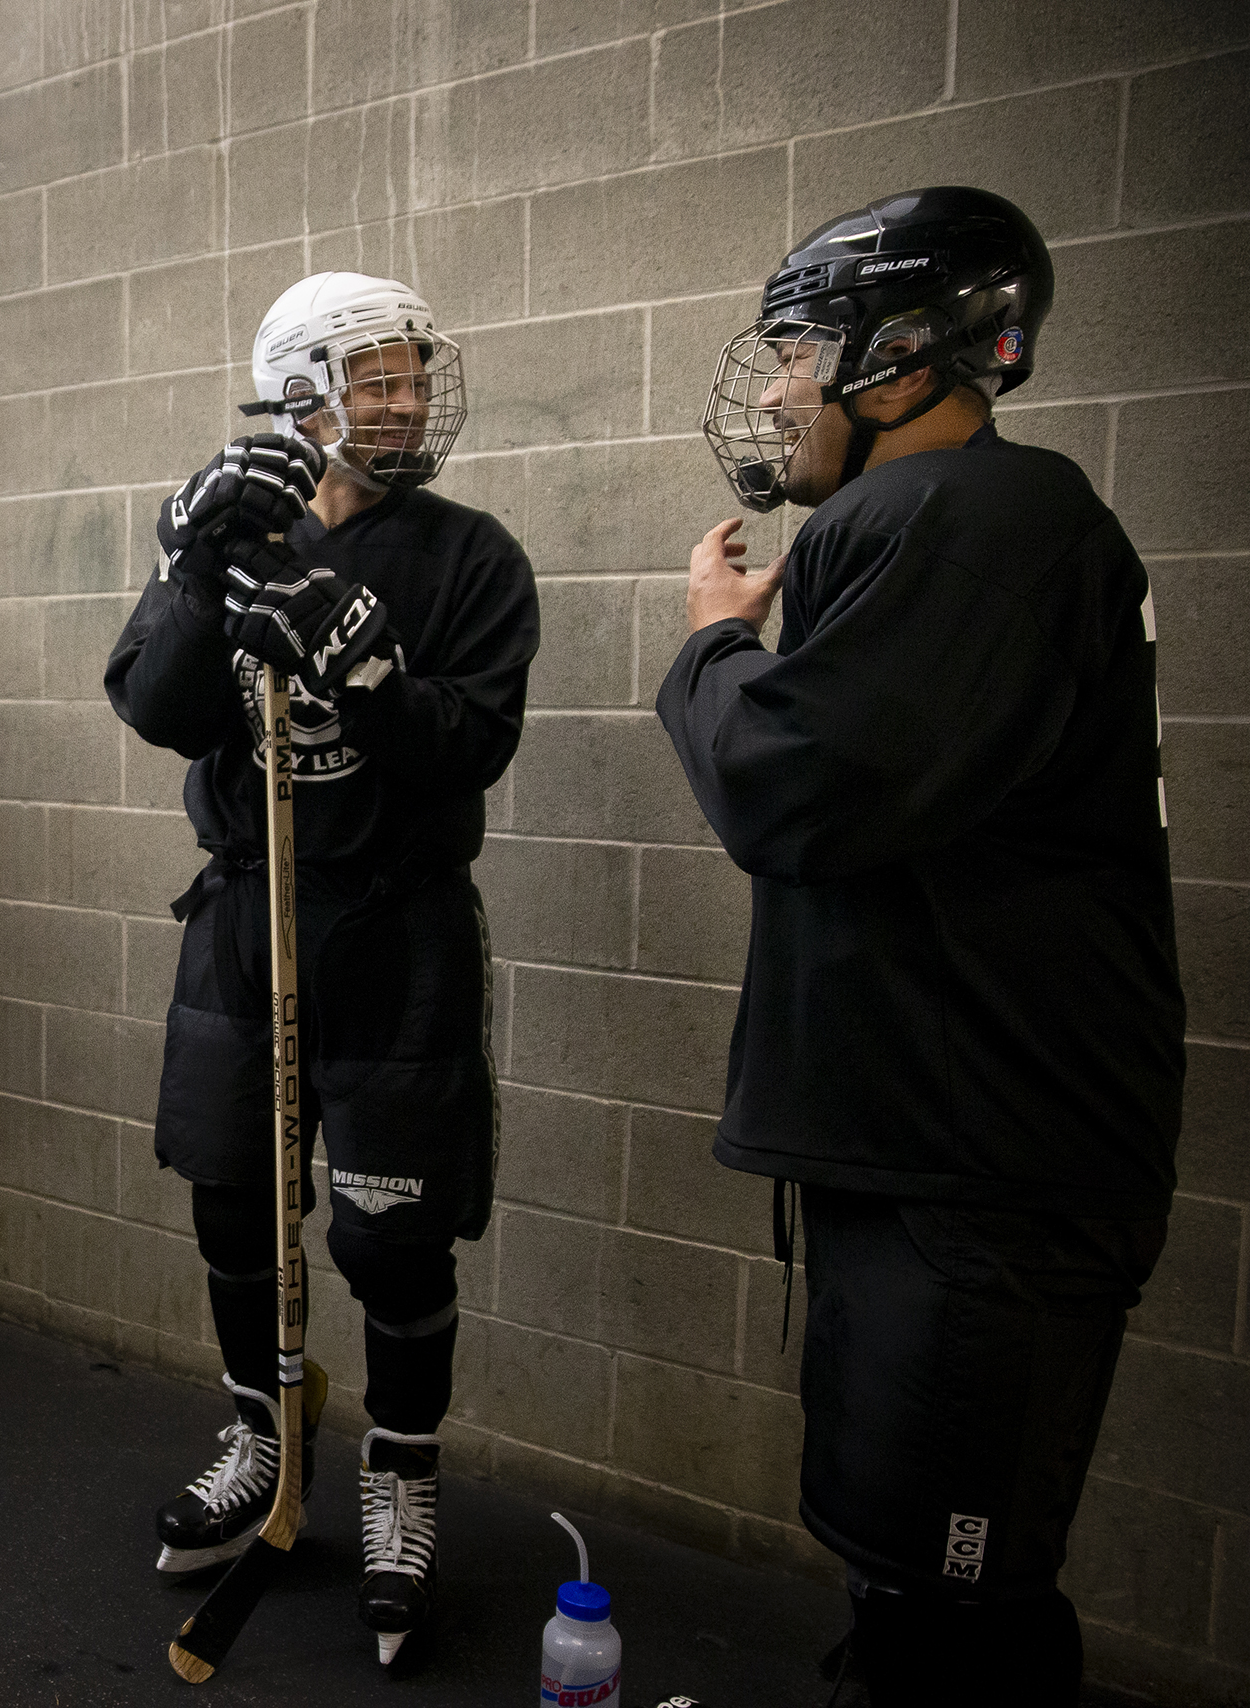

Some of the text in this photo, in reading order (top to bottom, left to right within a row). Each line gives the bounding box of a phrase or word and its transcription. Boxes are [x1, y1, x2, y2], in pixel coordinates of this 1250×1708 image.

[860, 258, 930, 276] BAUER
[398, 302, 429, 312] BAUER
[270, 330, 305, 352] BAUER
[842, 366, 898, 395] BAUER
[285, 398, 313, 411] BAUER
[313, 745, 361, 771] LEA
[282, 992, 302, 1328] SHER-WOOD
[332, 1168, 424, 1197] MISSION
[943, 1513, 988, 1580] CCM
[541, 1674, 562, 1693] PRO
[557, 1666, 621, 1707] GUAR
